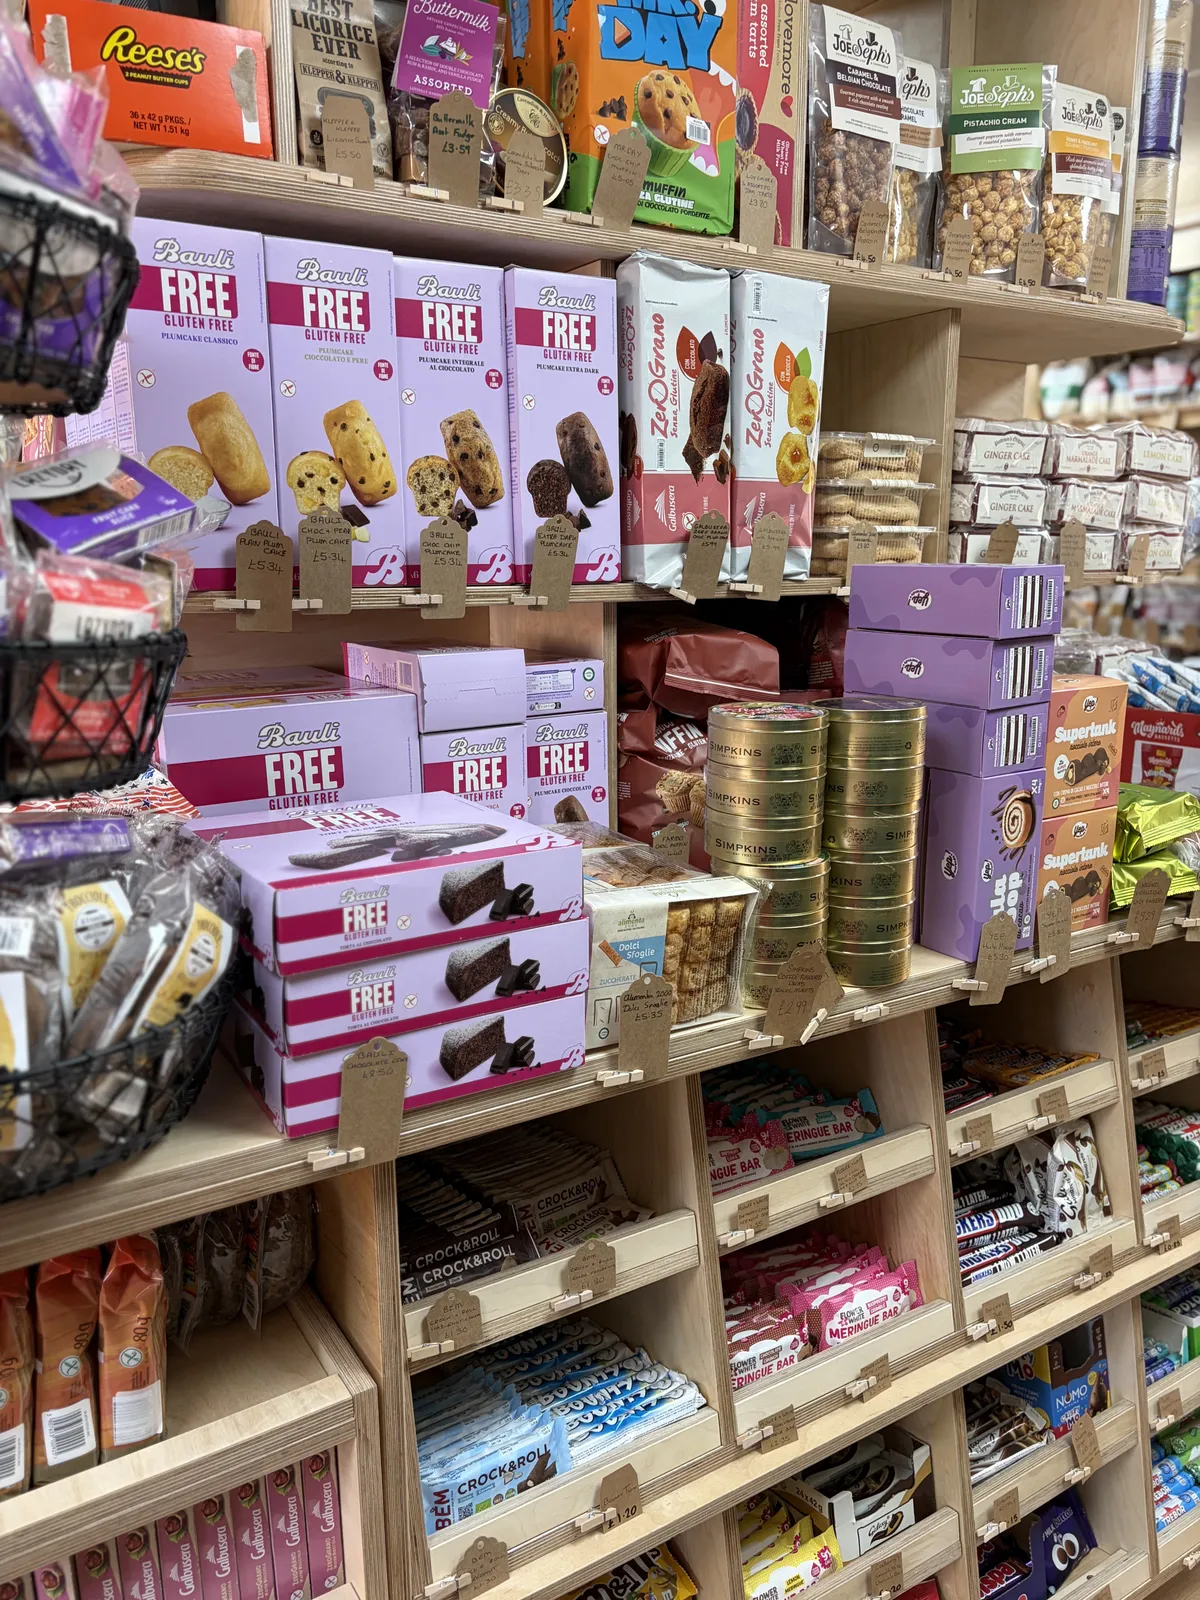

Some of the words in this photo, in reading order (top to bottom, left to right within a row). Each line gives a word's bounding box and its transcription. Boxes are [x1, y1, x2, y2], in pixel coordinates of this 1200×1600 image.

[307, 0, 354, 21] BEST
[413, 0, 492, 32] Buttermilk
[290, 9, 375, 46] LICORICE
[597, 3, 724, 71] DAY
[759, 3, 769, 68] assorted
[101, 26, 207, 73] Reese's
[311, 33, 362, 61] EVER
[749, 22, 759, 59] tarts
[322, 58, 347, 69] according
[847, 66, 873, 80] CARAMEL
[125, 71, 130, 79] 2
[131, 72, 151, 82] PEANUT
[152, 75, 173, 84] BUTTER
[174, 77, 190, 86] CUPS
[302, 65, 335, 80] KLEPPER
[335, 69, 346, 85] &
[347, 75, 380, 91] KLEPPER
[836, 71, 860, 87] BELGIAN
[861, 79, 892, 94] CHOCOLATE
[129, 110, 140, 120] 36
[147, 112, 157, 122] 42
[158, 115, 163, 124] g
[164, 115, 187, 126] PKGS.
[963, 118, 1000, 128] PISTACHIO
[1001, 116, 1028, 126] CREAM
[133, 121, 148, 132] NET
[149, 122, 161, 132] WT
[163, 124, 177, 135] 1.51
[179, 125, 190, 137] kg
[643, 179, 687, 198] MUFFIN
[644, 201, 679, 214] CIOCCOLATO
[680, 206, 710, 221] FONDENTE
[654, 193, 696, 211] GLUTINE
[153, 237, 236, 271] Bauli
[296, 257, 369, 287] Bauli
[160, 267, 233, 320] FREE
[416, 275, 482, 302] Bauli
[538, 286, 596, 312] Bauli
[302, 286, 366, 332] FREE
[164, 314, 205, 330] GLUTEN
[209, 318, 234, 333] FREE
[421, 300, 479, 343] FREE
[542, 311, 593, 351] FREE
[161, 331, 203, 343] PLUMCAKE
[204, 336, 239, 346] CLASSICO
[304, 328, 341, 343] GLUTEN
[344, 332, 367, 345] FREE
[318, 346, 354, 357] PLUMCAKE
[424, 340, 457, 355] GLUTEN
[458, 343, 479, 356] FREE
[543, 348, 572, 361] GLUTEN
[574, 351, 592, 363] FREE
[304, 353, 346, 363] CIOCCOLATO
[351, 356, 369, 365] PERE
[418, 356, 451, 366] PLUMCAKE
[452, 358, 485, 368] INTEGRALE
[438, 364, 475, 374] CIOCCOLATO
[536, 363, 566, 373] PLUMCAKE
[566, 365, 583, 374] EXTRA
[584, 367, 600, 375] DARK
[669, 368, 680, 408] Glutine
[764, 381, 775, 418] Glutine
[669, 409, 679, 440] Senza
[764, 419, 774, 449] Senza
[984, 450, 1013, 461] GINGER
[1013, 452, 1031, 461] CAKE
[668, 484, 676, 533] Galbusera
[990, 502, 1017, 513] GINGER
[1018, 504, 1034, 513] CAKE
[311, 515, 343, 524] BAULI
[251, 528, 280, 539] BAULI
[263, 540, 285, 550] PLUM
[264, 548, 287, 557] CAKE
[257, 721, 341, 750] Bauli
[536, 723, 588, 743] Bauli
[1054, 718, 1118, 745] Supertank
[1131, 719, 1185, 739] Maynards
[448, 737, 507, 758] Bauli
[709, 739, 763, 758] SIMPKINS
[539, 742, 586, 777] FREE
[265, 747, 339, 797] FREE
[452, 756, 504, 794] FREE
[540, 775, 567, 787] GLUTEN
[568, 772, 586, 783] FREE
[269, 793, 311, 811] GLUTEN
[314, 790, 340, 806] FREE
[534, 787, 561, 797] PLUMCAKE
[562, 784, 592, 794] CIOCCOLATO
[708, 787, 761, 806] SIMPKINS
[715, 837, 777, 855] SIMPKINS
[1043, 841, 1110, 872] Supertank
[339, 884, 391, 905] Bauli
[343, 900, 388, 934] FREE
[618, 939, 641, 953] Dolci
[626, 948, 656, 960] Sfoglie
[599, 973, 637, 986] ZUCCHERATE
[787, 1127, 832, 1144] ERINGUE
[833, 1121, 854, 1134] BAR
[422, 1244, 517, 1286] CROCK&ROLL
[828, 1314, 880, 1340] MERINGUE
[882, 1305, 899, 1321] BAR
[840, 1306, 864, 1320] FLOWER
[848, 1312, 865, 1325] WHITE
[74, 1320, 95, 1350] 80g
[133, 1315, 152, 1343] 80g
[1056, 1384, 1088, 1409] NOMO
[457, 1443, 552, 1497] CROCK&ROLL
[321, 1481, 335, 1533] Galbusera
[795, 1486, 805, 1498] 24
[810, 1496, 818, 1508] 42
[1162, 1505, 1187, 1527] TREBOR
